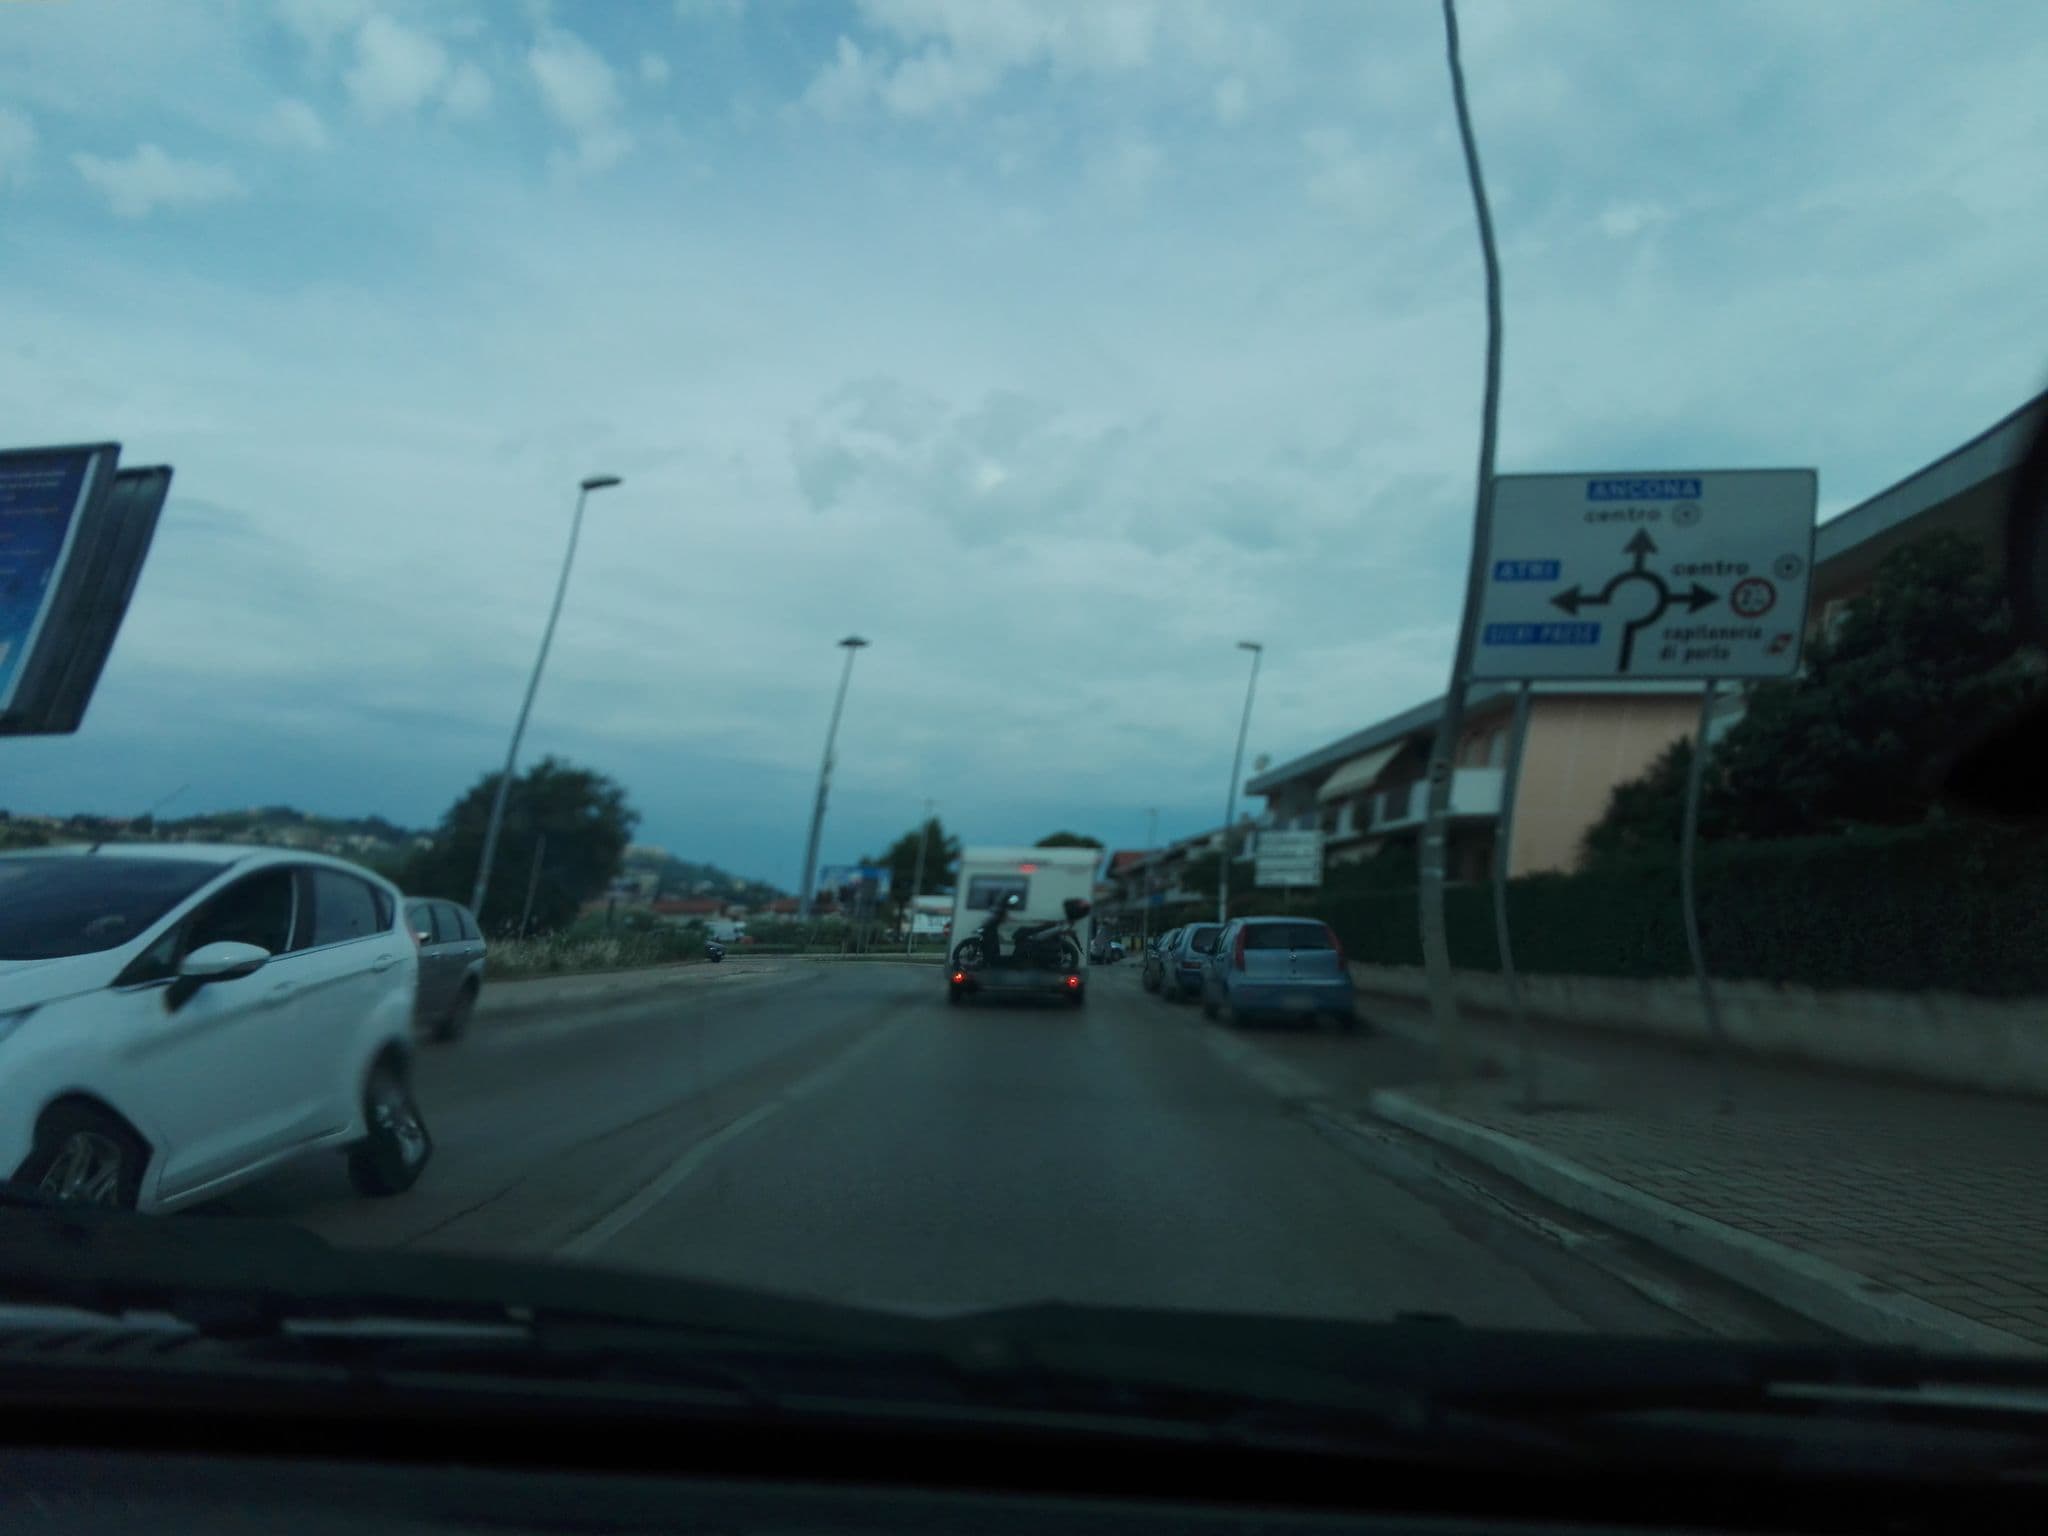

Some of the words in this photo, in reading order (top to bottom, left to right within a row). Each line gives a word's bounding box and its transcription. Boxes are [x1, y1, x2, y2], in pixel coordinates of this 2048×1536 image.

[1590, 481, 1698, 498] ANCONA
[1583, 505, 1662, 522] centro
[1670, 560, 1750, 577] centro
